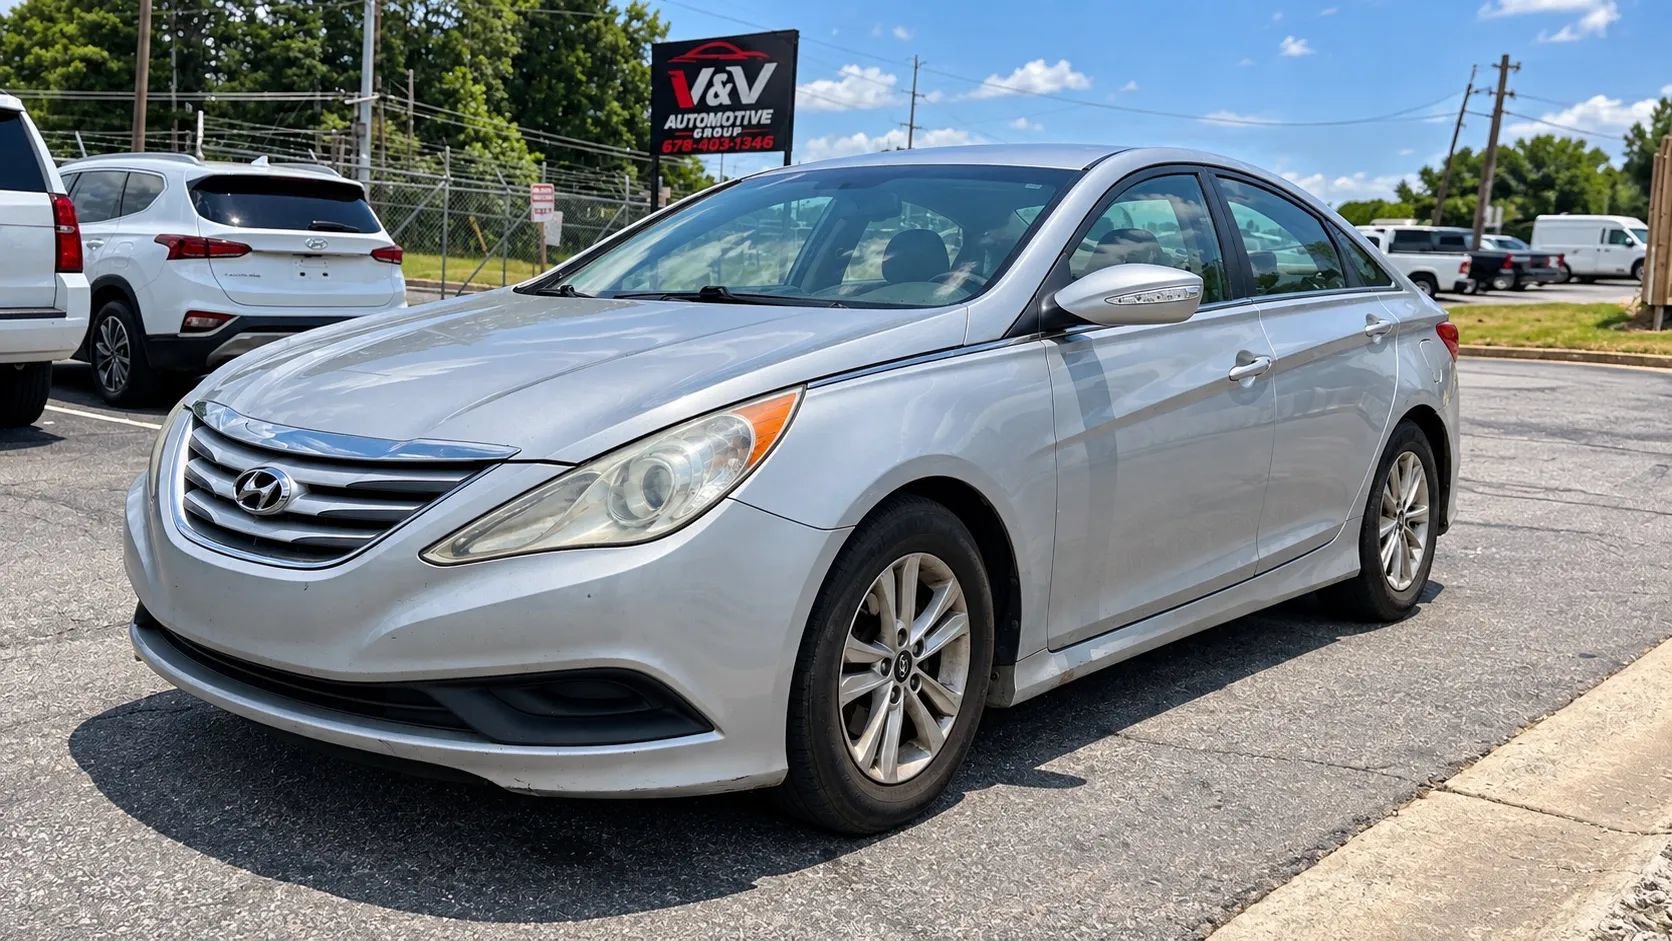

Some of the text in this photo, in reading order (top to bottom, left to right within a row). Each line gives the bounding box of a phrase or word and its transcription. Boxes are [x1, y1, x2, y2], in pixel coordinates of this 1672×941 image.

[667, 62, 778, 108] V&V
[664, 109, 773, 129] AUTOMOTIVE
[693, 127, 742, 138] GROUP
[662, 136, 774, 153] 678-403-1346
